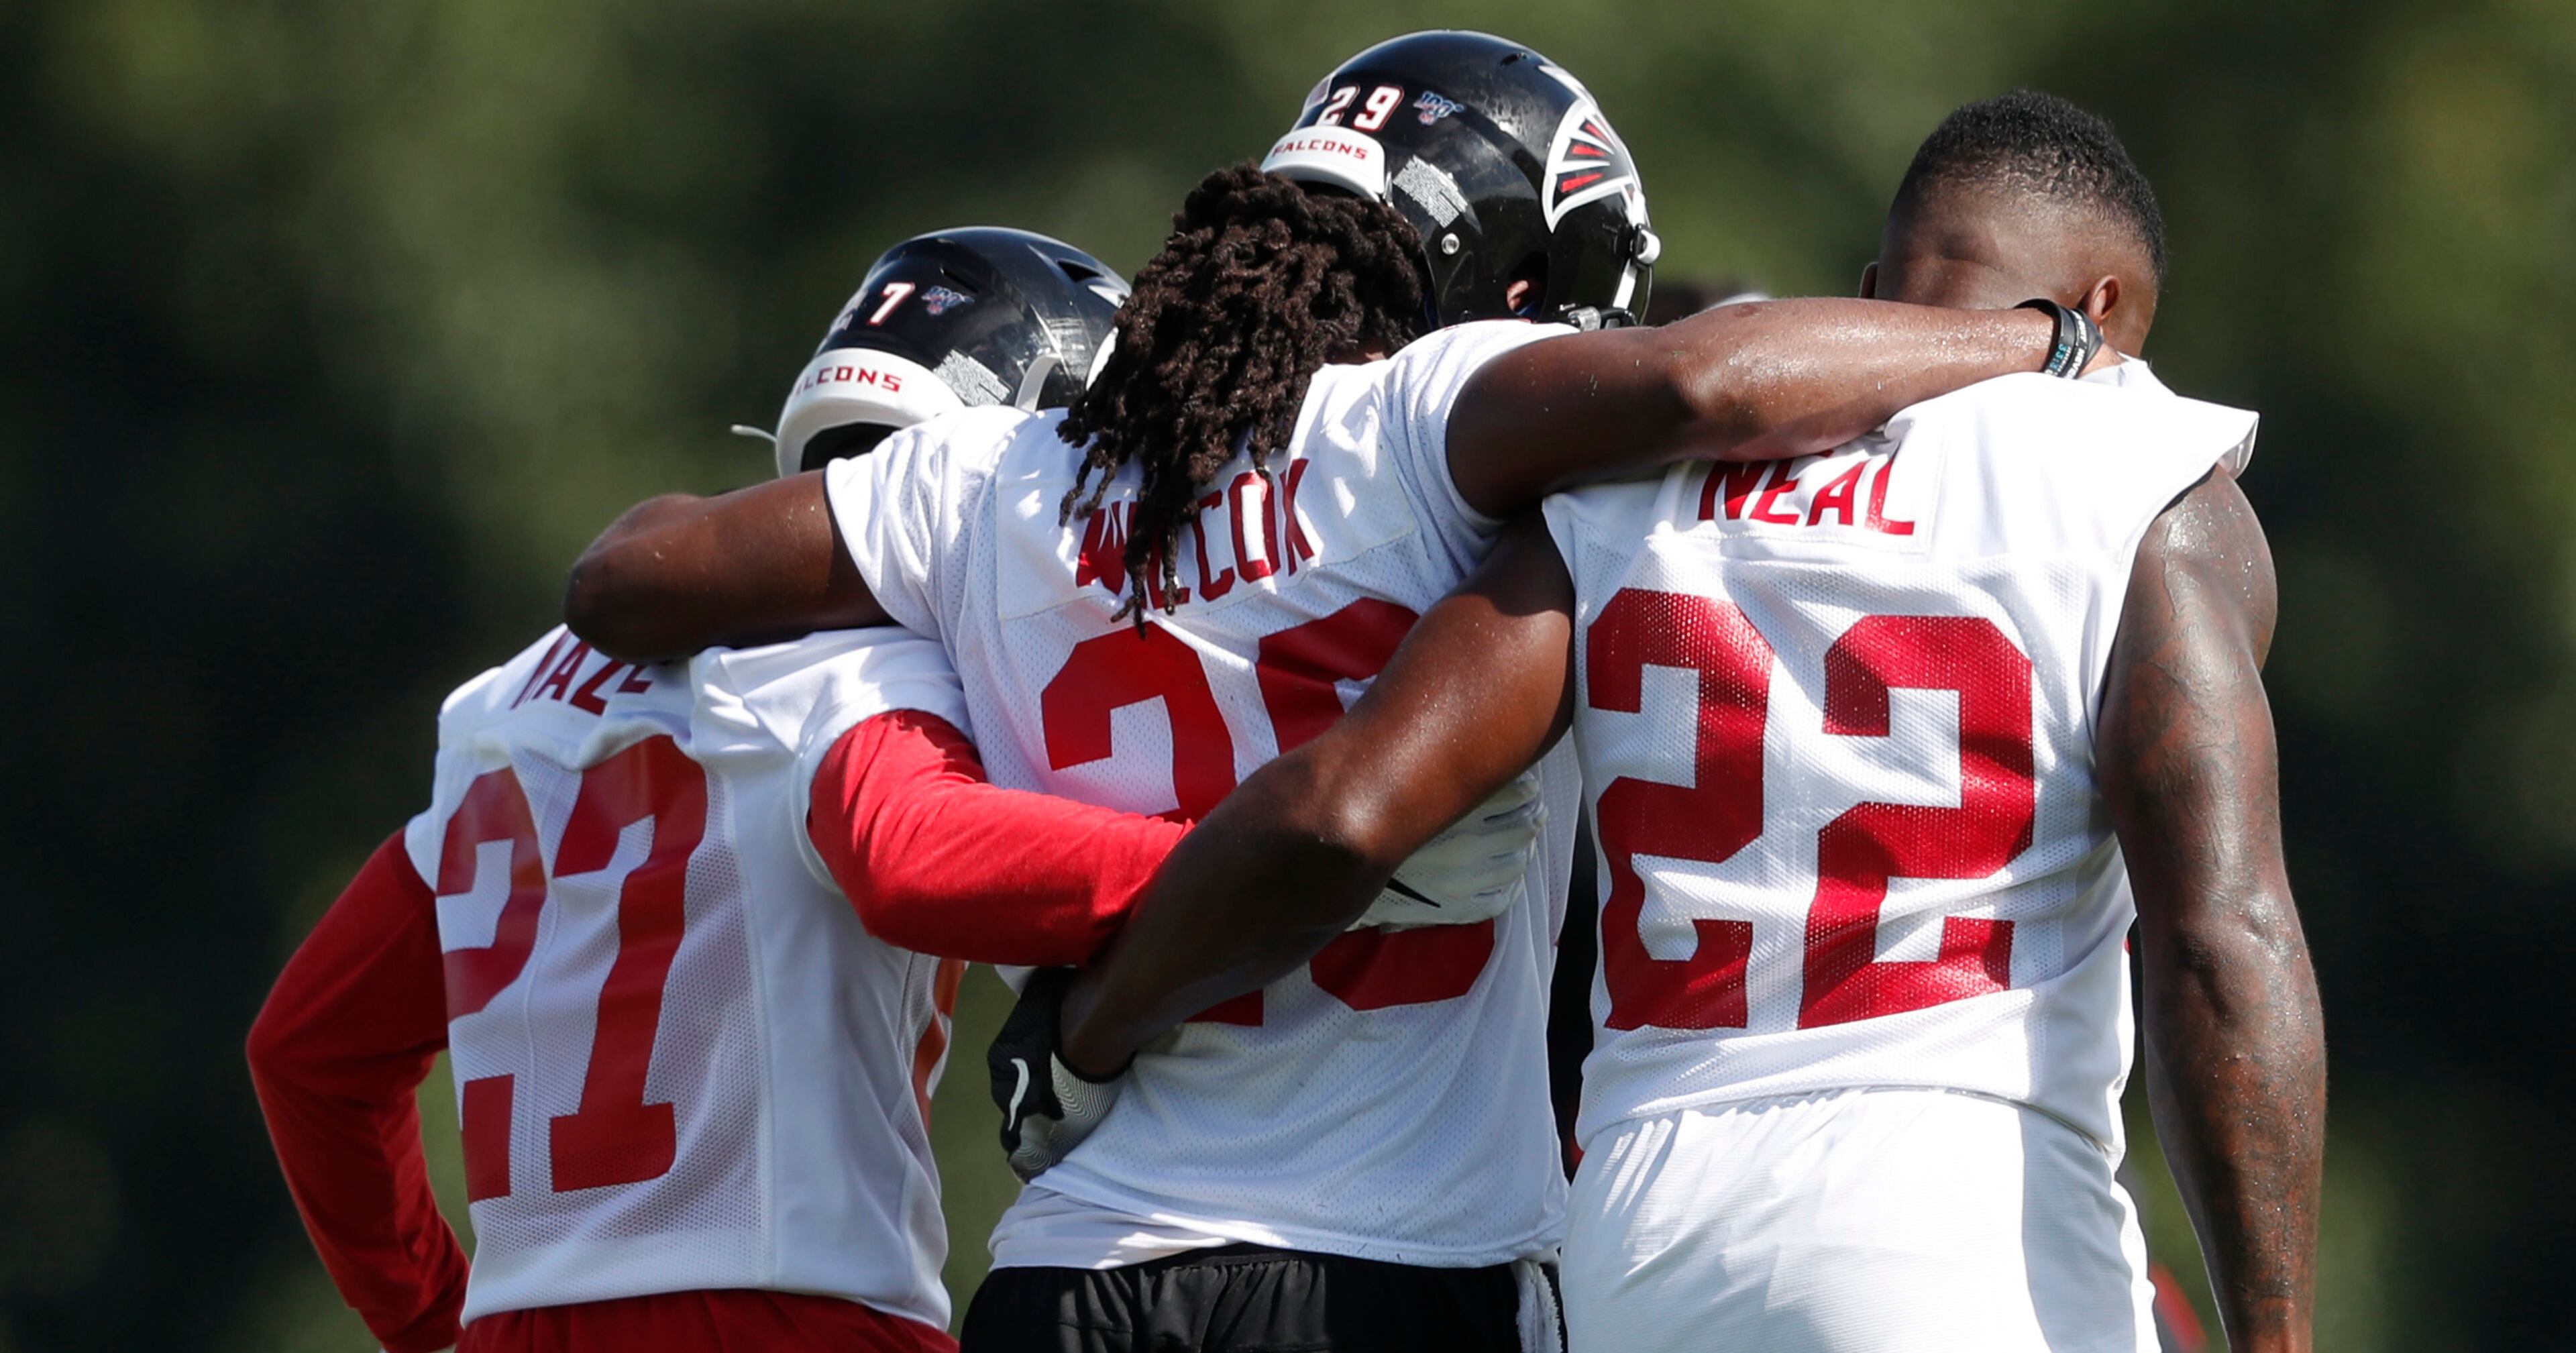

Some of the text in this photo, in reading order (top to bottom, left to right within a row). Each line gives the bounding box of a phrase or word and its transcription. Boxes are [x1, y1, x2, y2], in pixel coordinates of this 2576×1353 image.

[1272, 139, 1368, 160] FALCONS
[1315, 83, 1405, 132] 29
[796, 366, 902, 396] LCONS
[1076, 458, 1316, 610] WLCOX
[1697, 448, 1915, 535] NEAL
[1585, 587, 2035, 1032] 22
[436, 735, 708, 1204] 27
